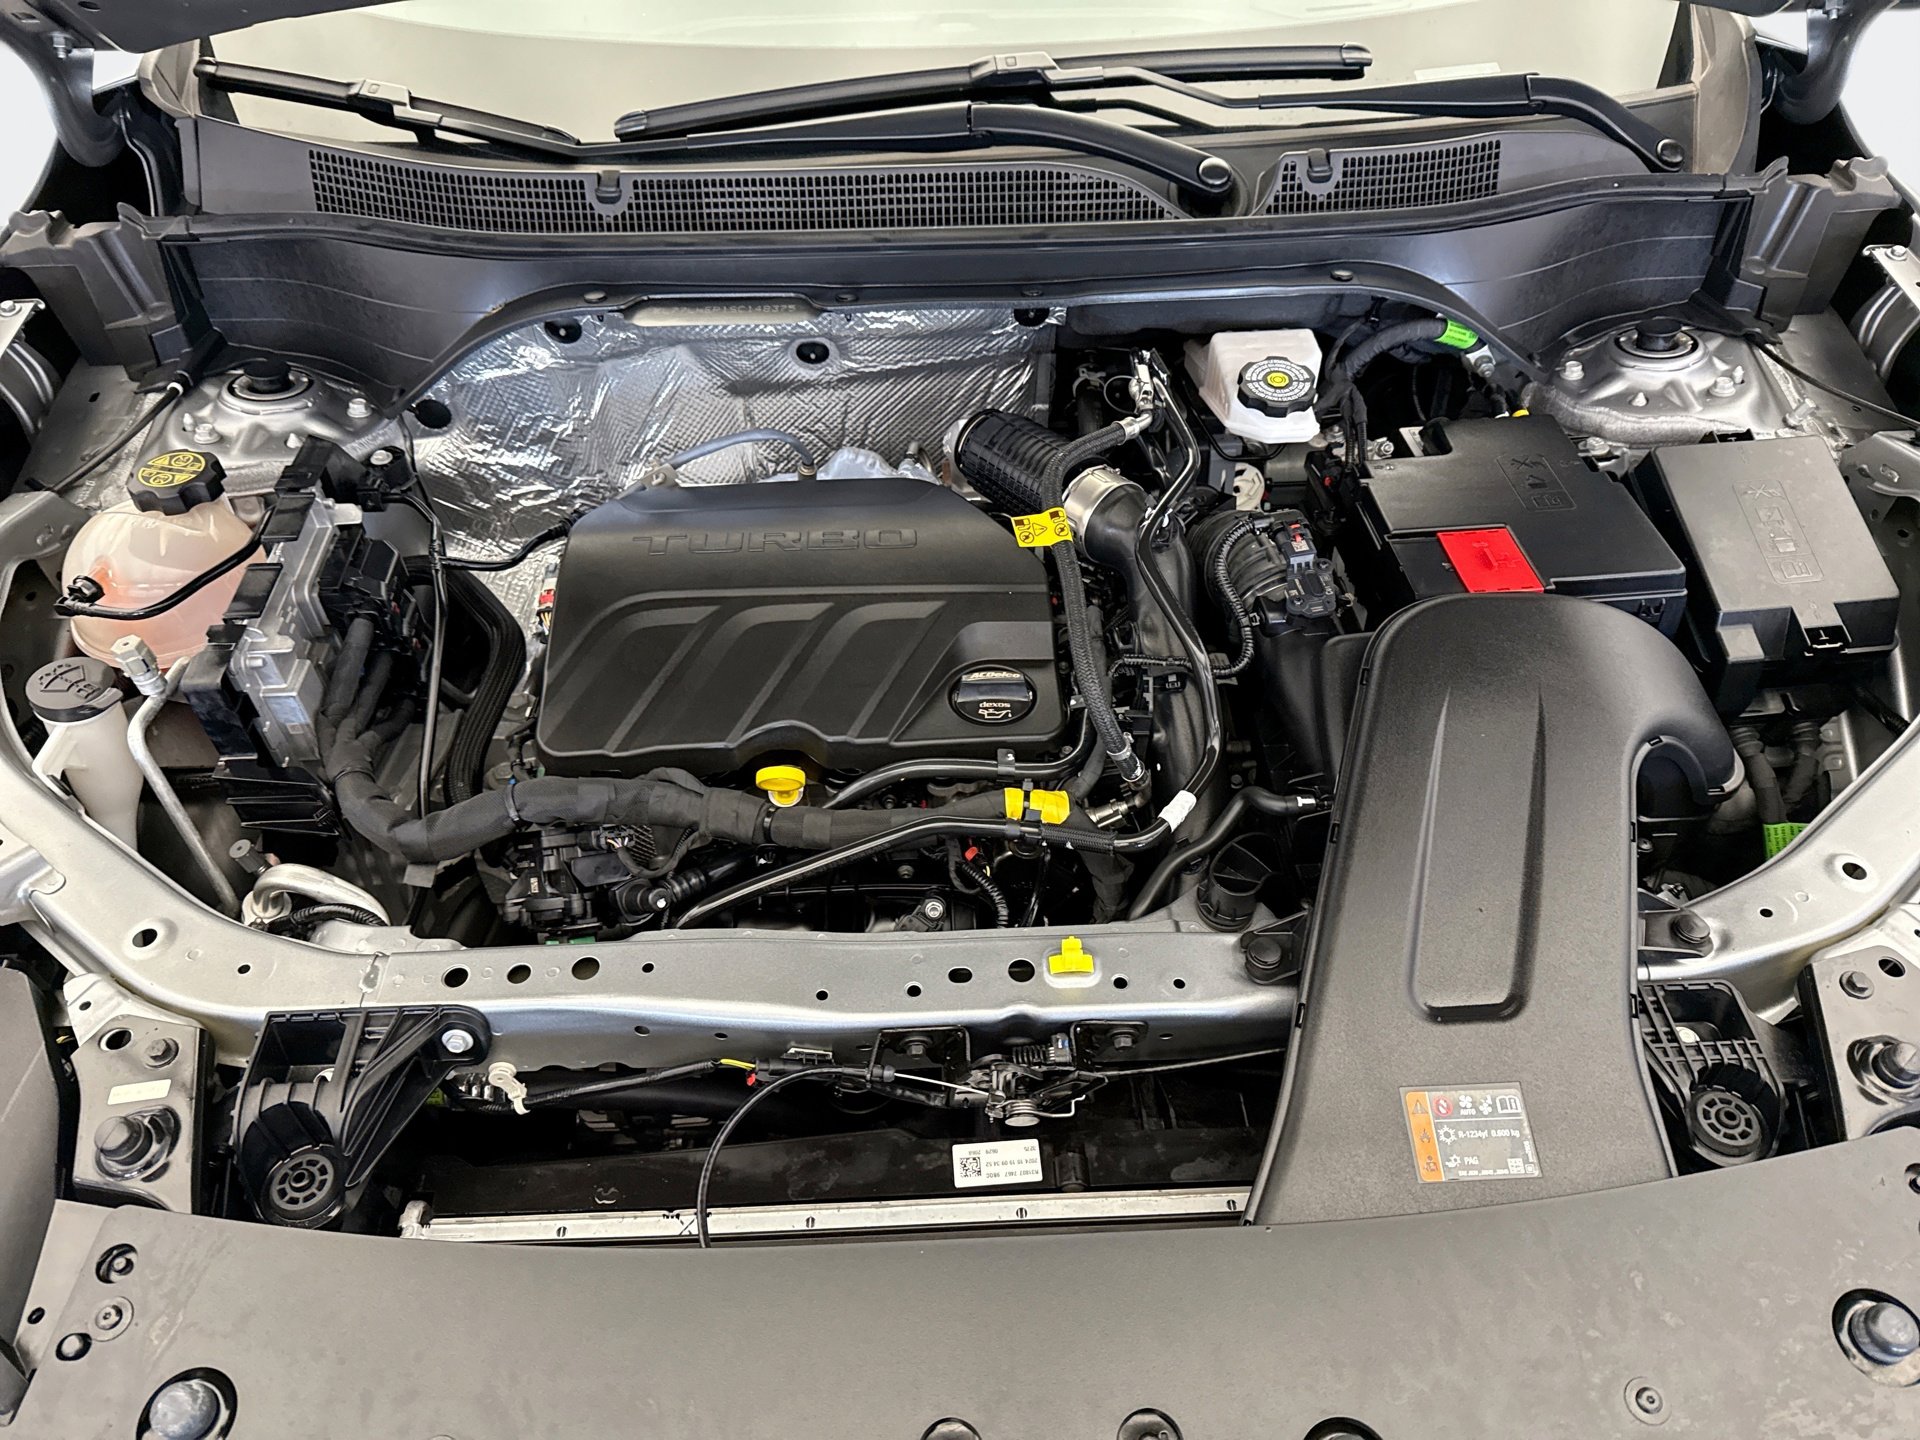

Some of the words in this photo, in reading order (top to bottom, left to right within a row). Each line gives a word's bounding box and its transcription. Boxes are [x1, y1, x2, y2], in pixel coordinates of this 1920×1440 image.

[632, 528, 918, 556] TURBO
[969, 671, 1021, 679] ACDelco
[1460, 1108, 1476, 1116] AUTO
[1510, 1128, 1520, 1138] kg
[1464, 1156, 1479, 1165] PAG
